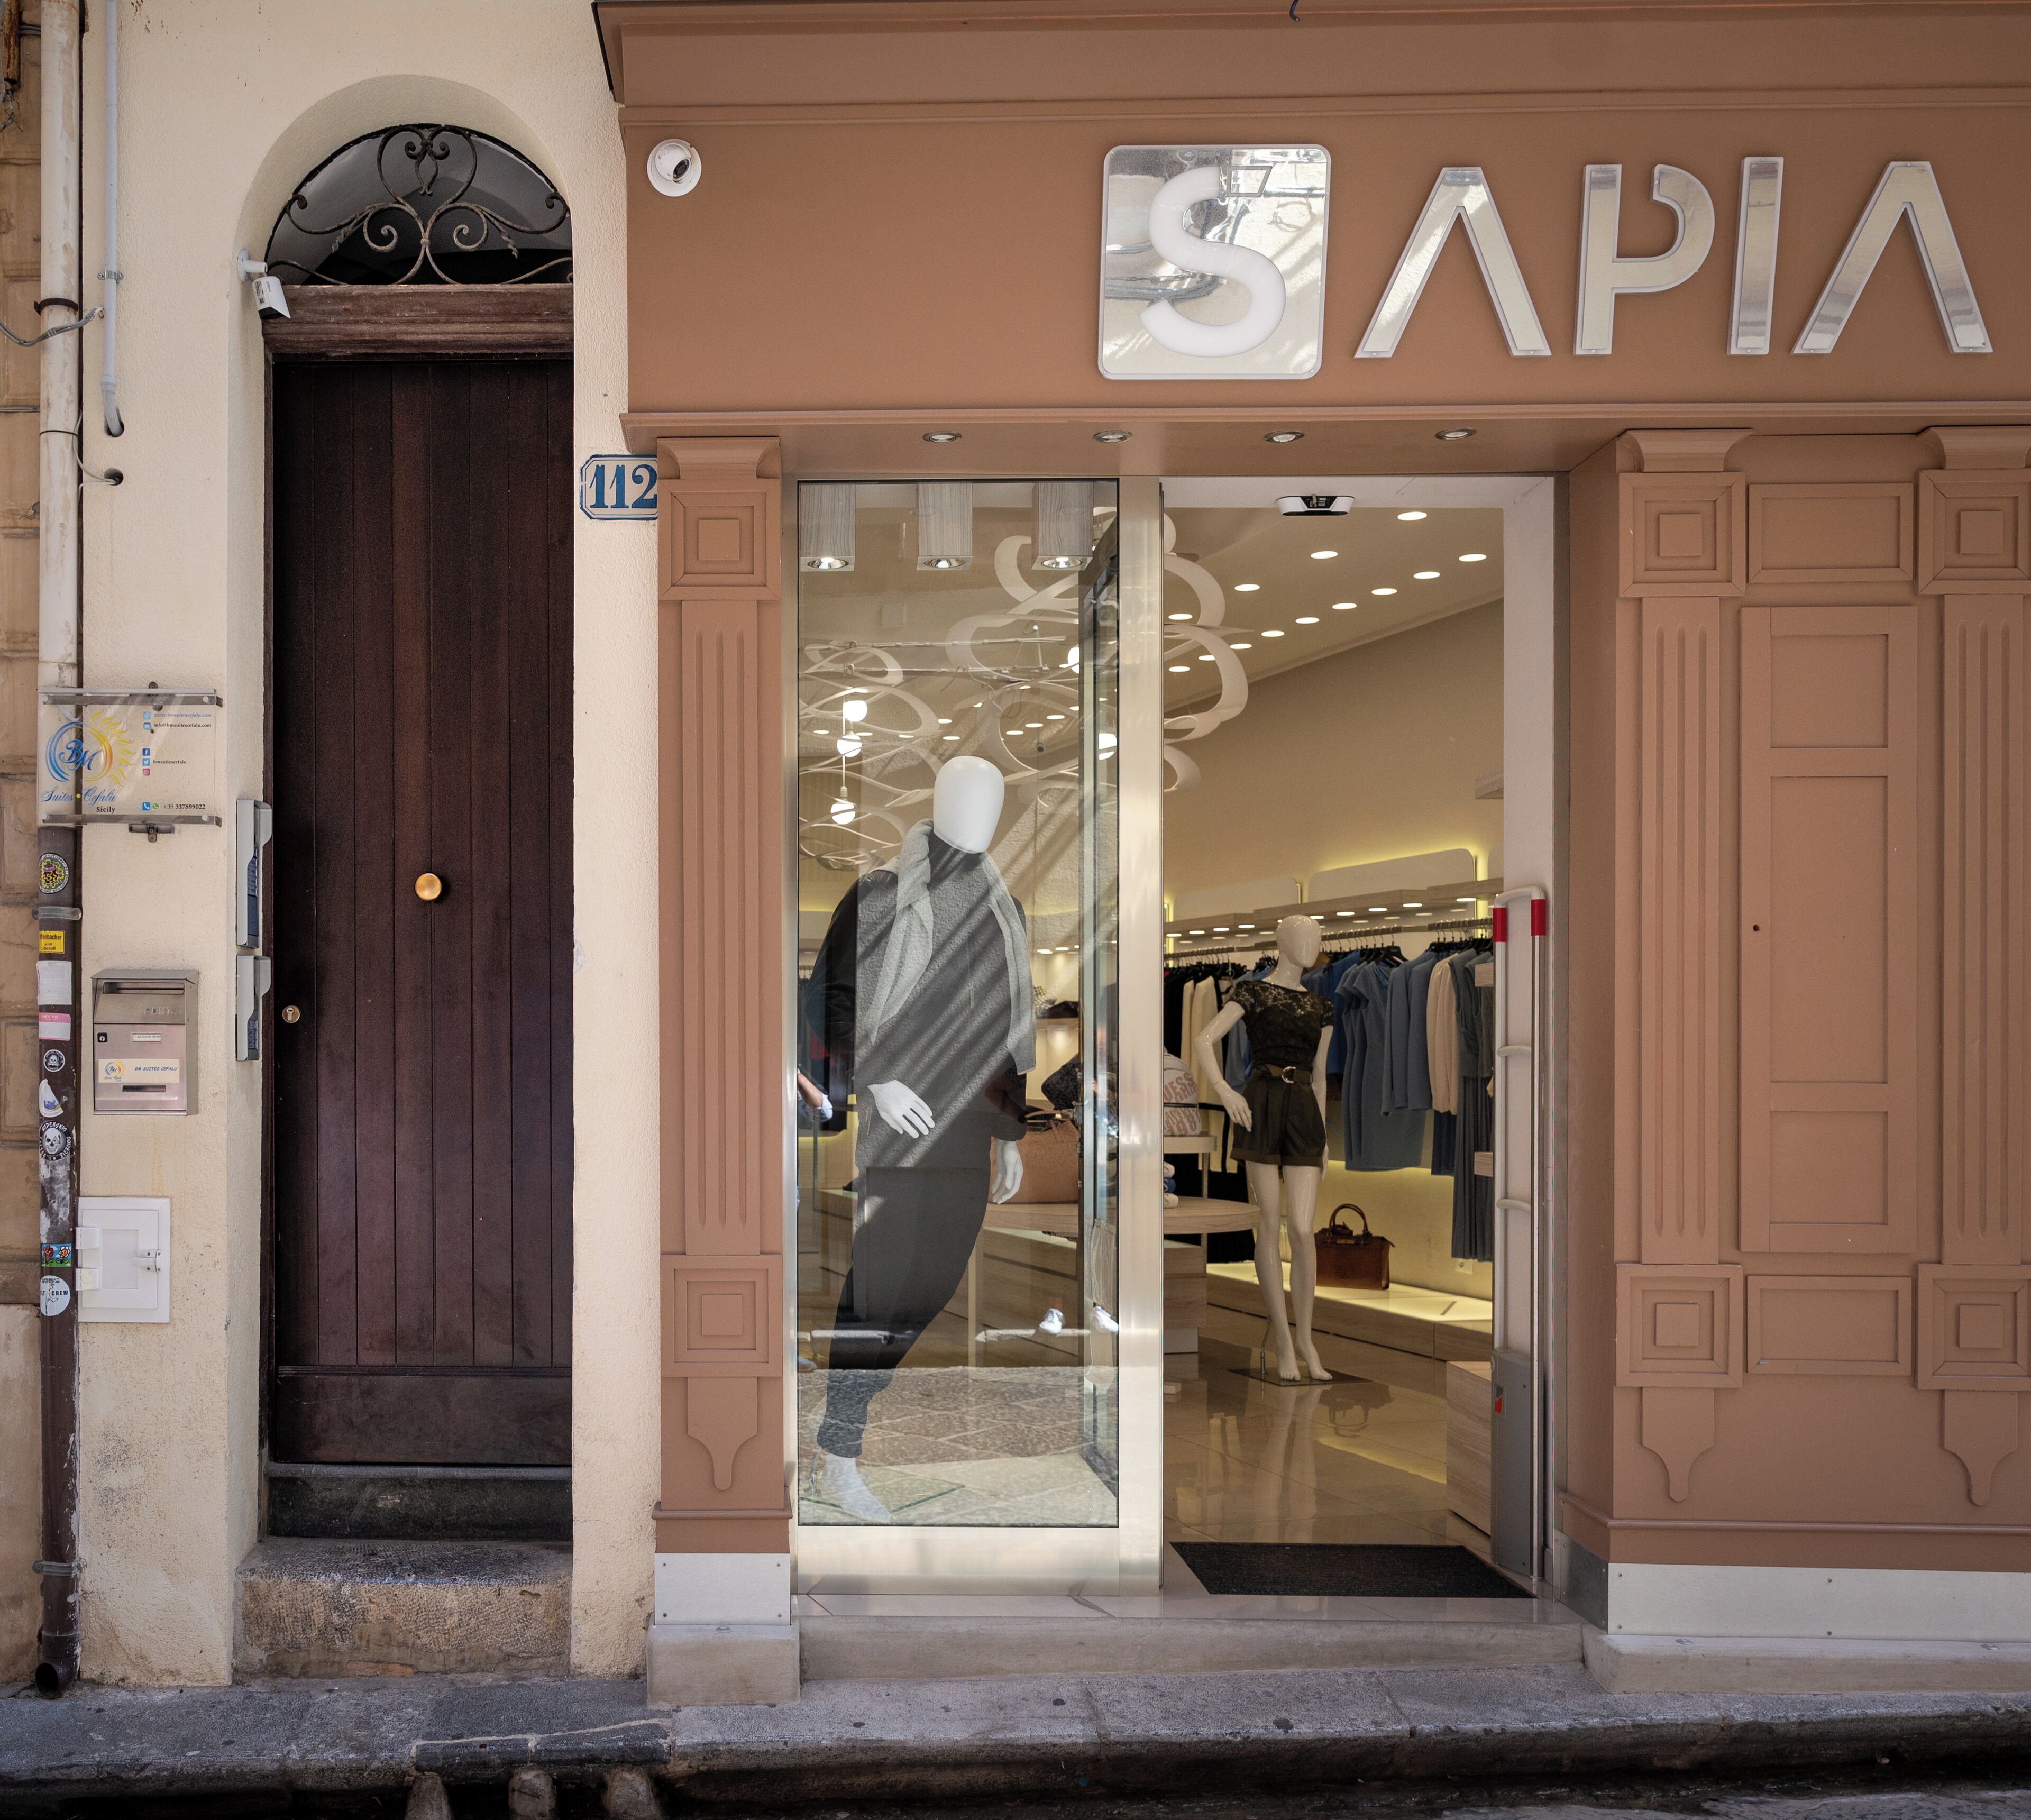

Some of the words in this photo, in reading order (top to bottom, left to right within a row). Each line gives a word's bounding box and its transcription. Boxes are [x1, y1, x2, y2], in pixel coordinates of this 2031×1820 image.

[1140, 157, 1993, 358] SAPIA
[589, 464, 657, 508] 112
[41, 786, 74, 802] Suites
[144, 1007, 177, 1016] POSTA
[1164, 1072, 1195, 1102] UESS
